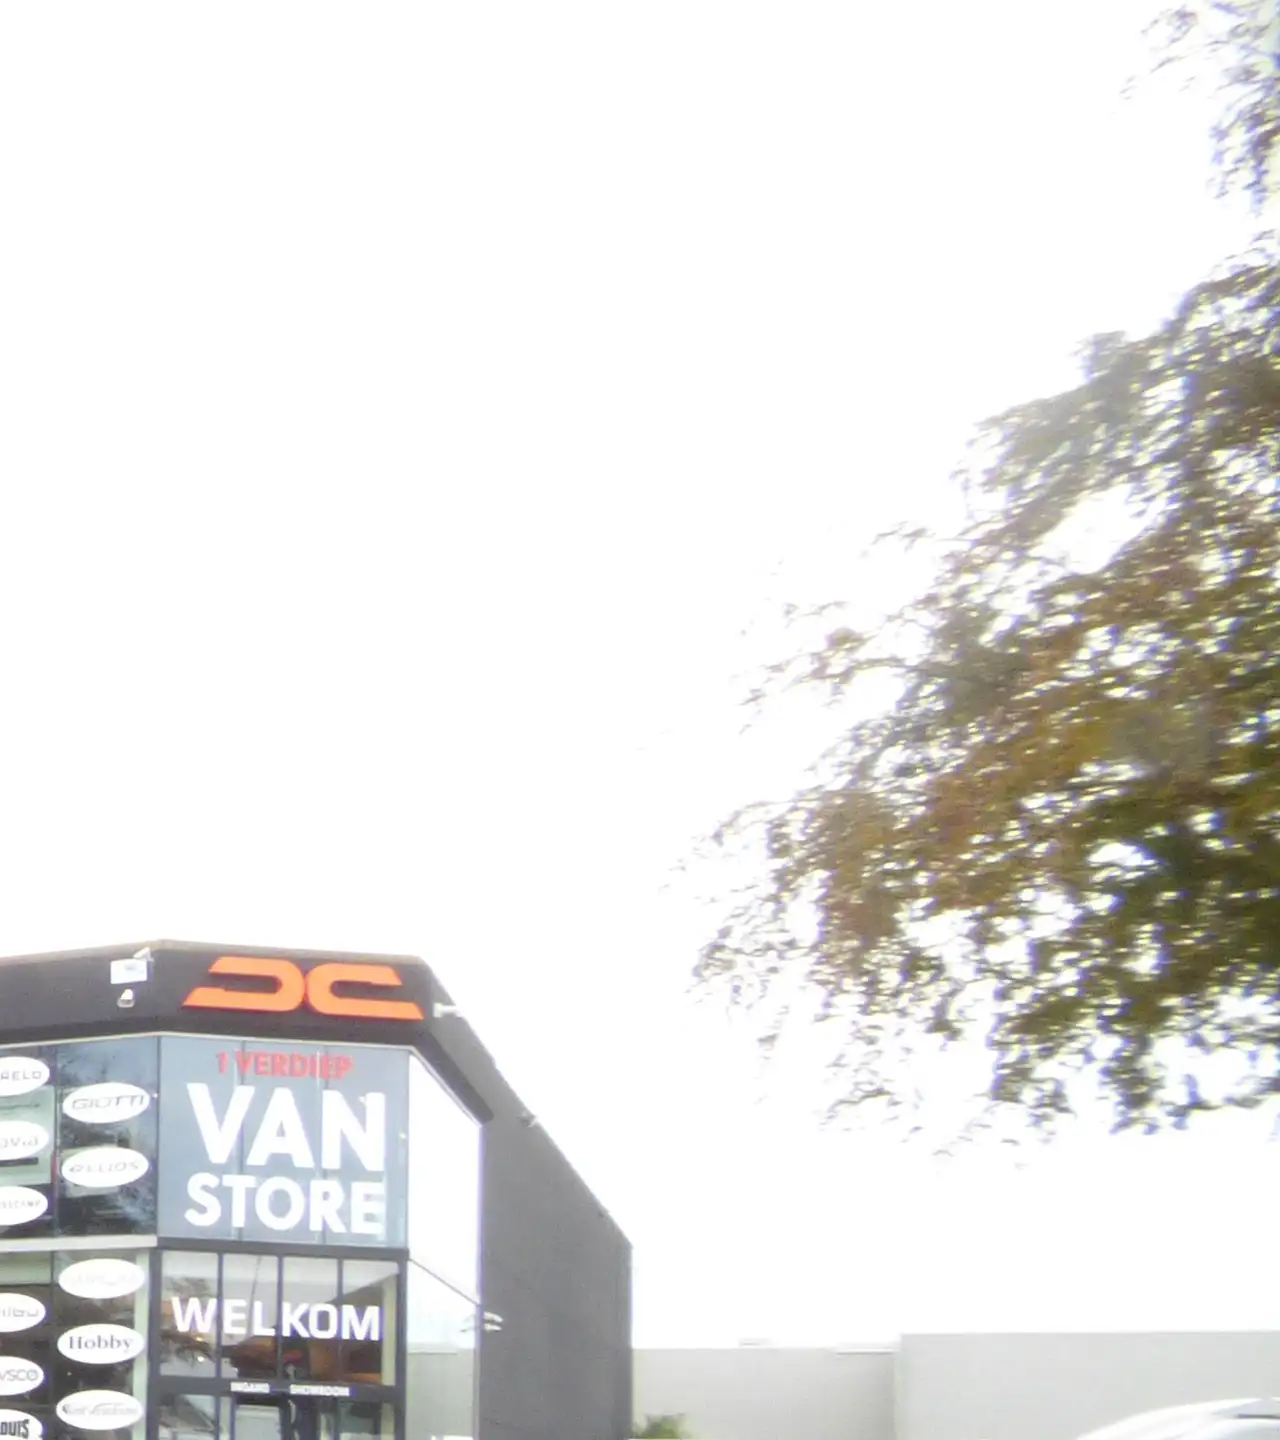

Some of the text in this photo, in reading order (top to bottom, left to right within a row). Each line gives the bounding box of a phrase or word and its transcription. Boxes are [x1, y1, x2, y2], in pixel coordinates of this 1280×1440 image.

[235, 1049, 355, 1079] VERDIEP
[72, 1094, 144, 1110] GIOTTI
[186, 1082, 386, 1172] VAN
[184, 1172, 385, 1234] STORE
[171, 1297, 380, 1341] WELKOM
[69, 1335, 134, 1353] Hobby
